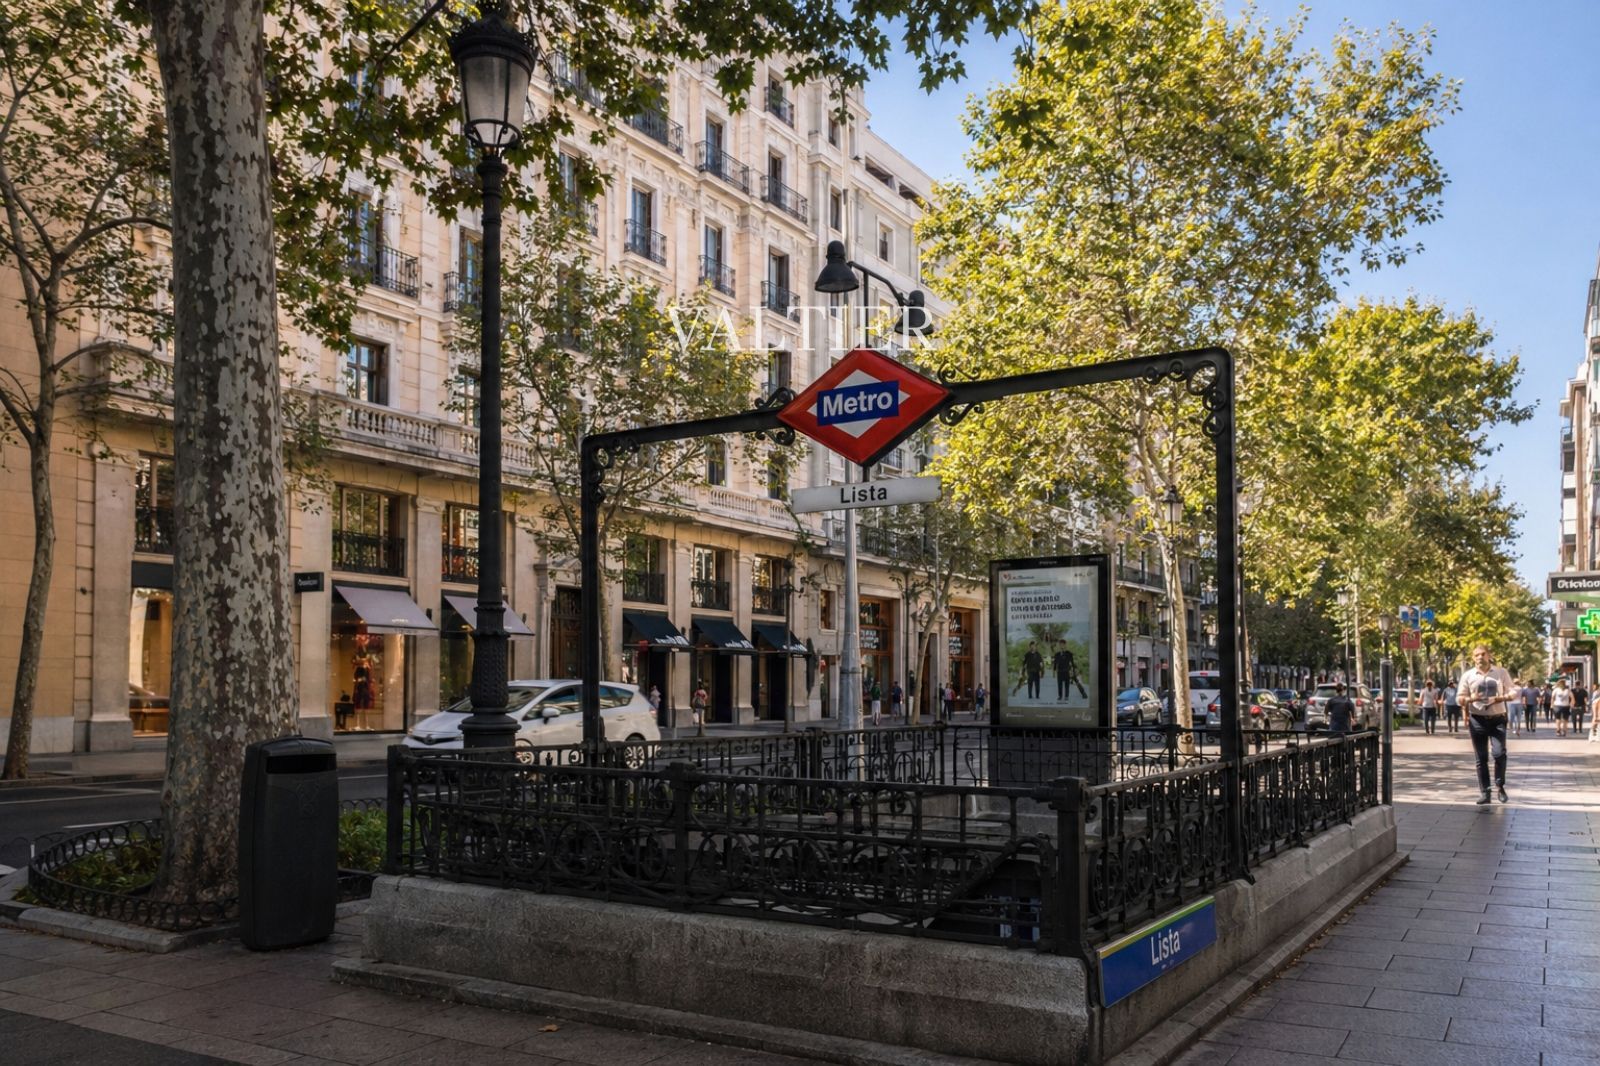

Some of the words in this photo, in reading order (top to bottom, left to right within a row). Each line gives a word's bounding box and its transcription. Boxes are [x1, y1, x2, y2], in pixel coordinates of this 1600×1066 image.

[823, 389, 893, 418] Metro
[840, 484, 888, 504] Lista
[1151, 928, 1181, 965] Lista
